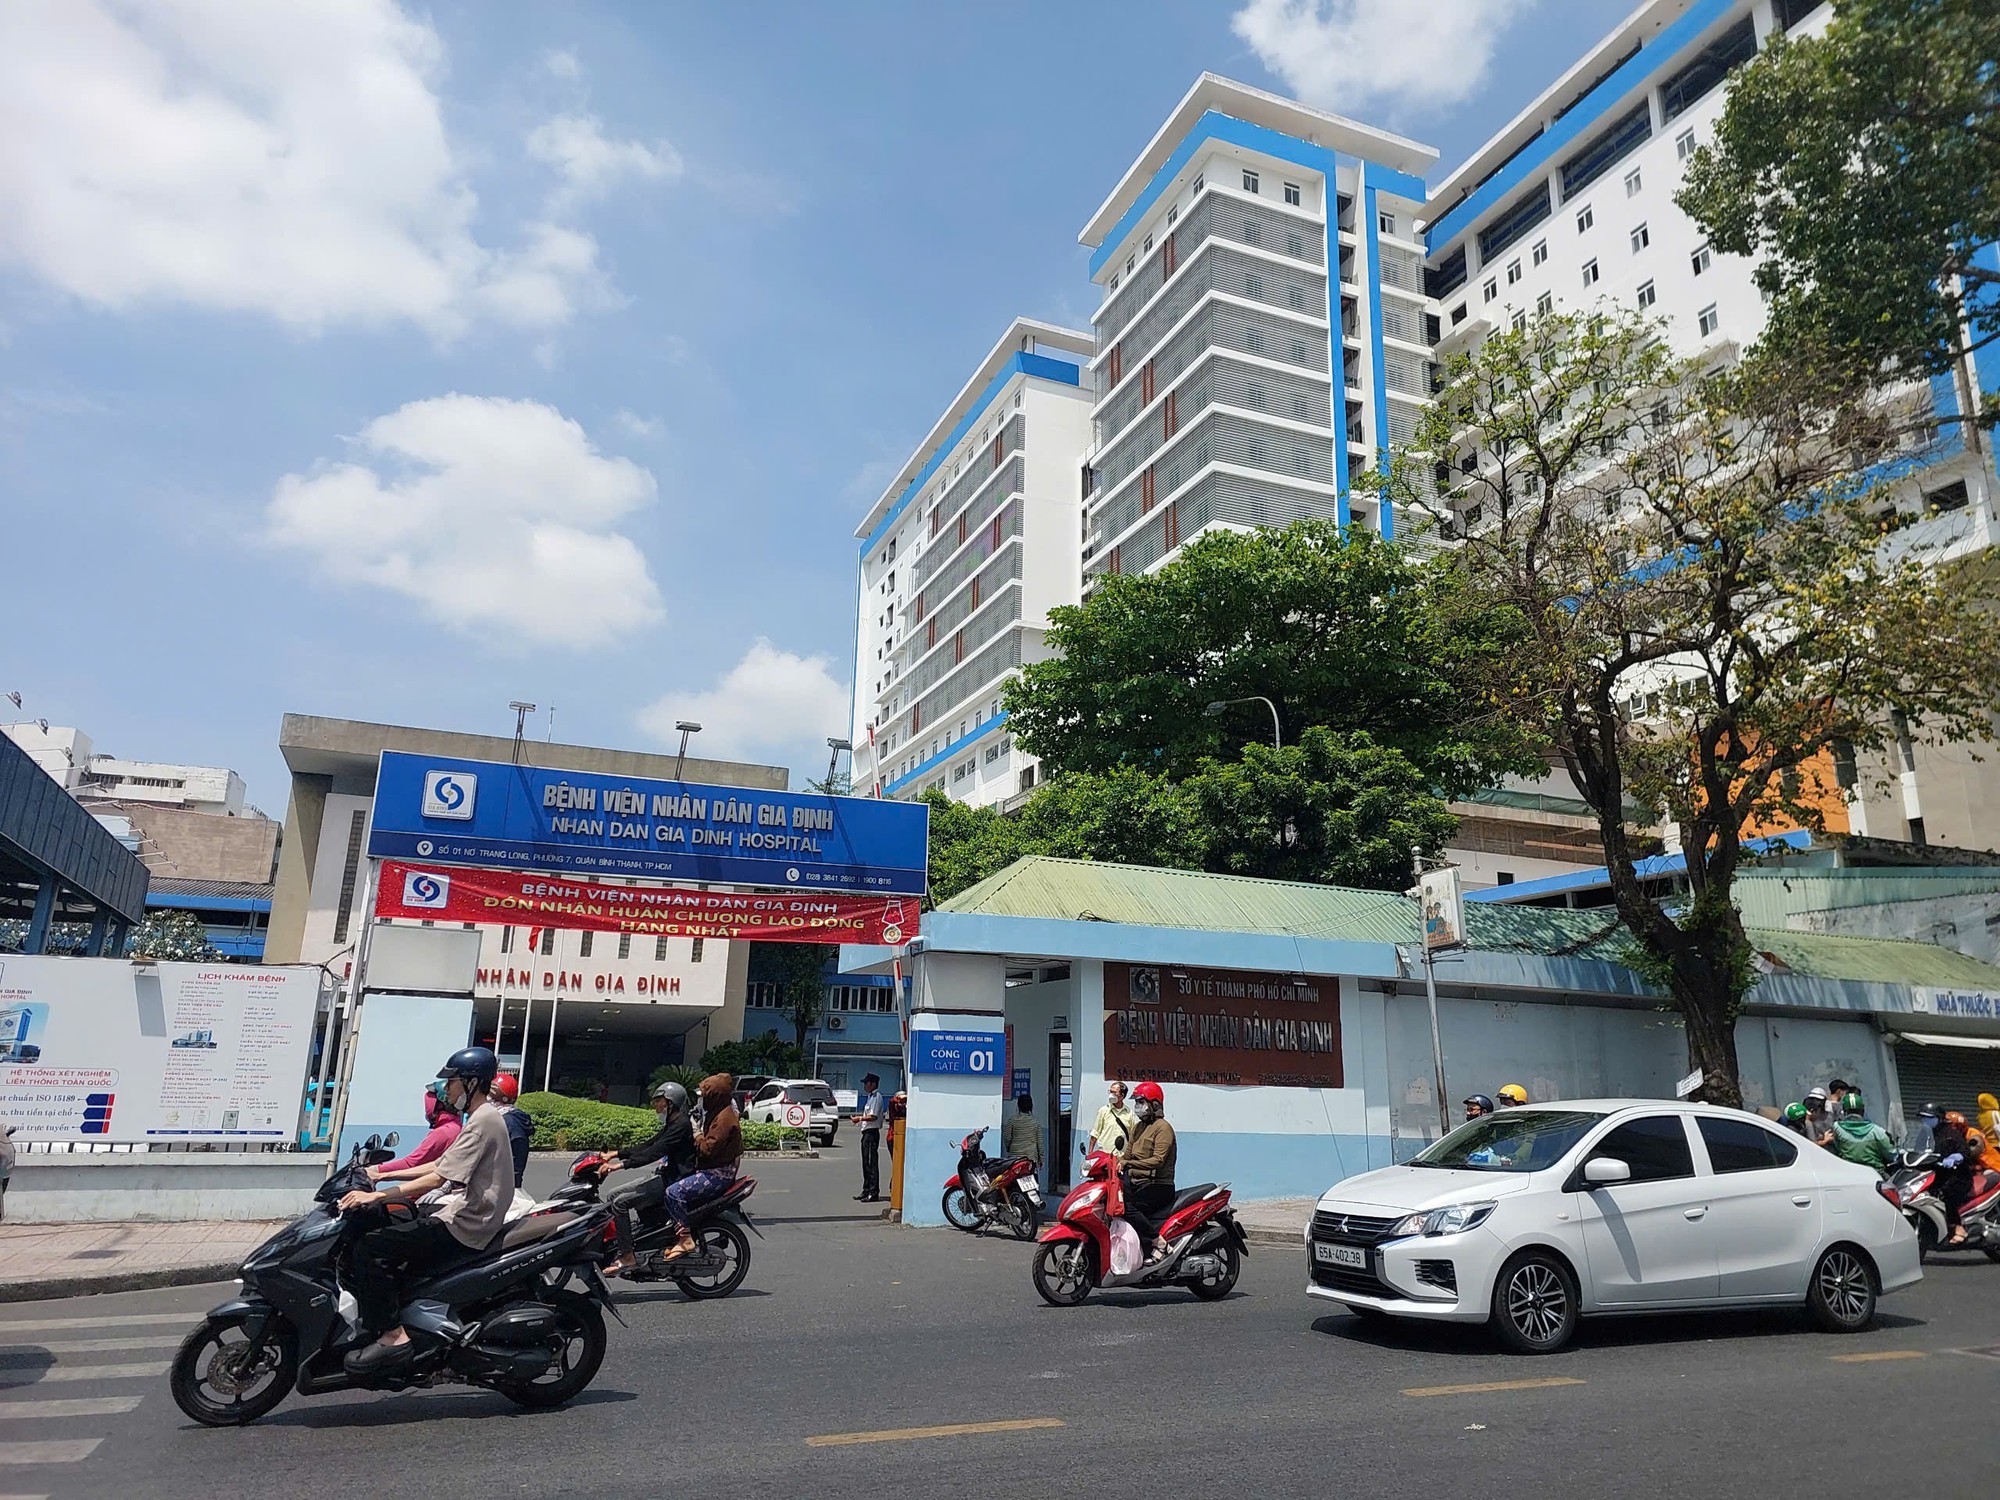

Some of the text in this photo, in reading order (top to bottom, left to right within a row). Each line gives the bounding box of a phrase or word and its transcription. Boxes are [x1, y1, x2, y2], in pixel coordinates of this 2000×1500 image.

[543, 781, 834, 832] BỆNH VIỆN NHÂN DÂN GIA ĐỊNH
[551, 816, 822, 853] NHAN DAN GIA DINH HOSPITAL
[438, 844, 450, 855] SỐ
[452, 847, 461, 855] 01
[479, 849, 507, 859] TRANG
[508, 851, 531, 861] LONG,
[533, 853, 564, 863] PHƯỜNG
[575, 856, 596, 866] QUẬN
[598, 857, 615, 867] BÌNH
[822, 873, 838, 882] 3841
[521, 883, 837, 914] BỆNH VIỆN NHÂN DÂN GIA ĐỊNH
[484, 896, 865, 929] ĐÓN NHẬN HUÂN CHƯƠNG LAO ĐỘNG
[620, 920, 742, 937] HẠNG NHẤT
[197, 973, 286, 983] LỊCH KHÁM BỆNH
[476, 967, 531, 984] NHÂN
[543, 971, 582, 988] DÂN
[637, 974, 681, 993] ĐỊNH
[1179, 978, 1194, 995] SỞ
[1193, 980, 1200, 995] Y
[1201, 974, 1214, 996] TẾ
[1215, 978, 1246, 999] THÀNH
[1247, 979, 1266, 1000] PHỐ
[1267, 979, 1279, 1000] HỒ
[1297, 984, 1319, 1003] MINH
[1117, 1003, 1333, 1057] BỆNH VIỆN NHÂN DÂN GIA ĐỊNH
[934, 1061, 959, 1071] GATE
[969, 1050, 994, 1072] 01
[26, 1068, 56, 1076] THỐNG
[77, 1070, 111, 1078] NGHIỆM
[87, 1078, 112, 1086] QUỐC
[53, 1094, 76, 1102] 15189
[10, 1108, 25, 1116] thu
